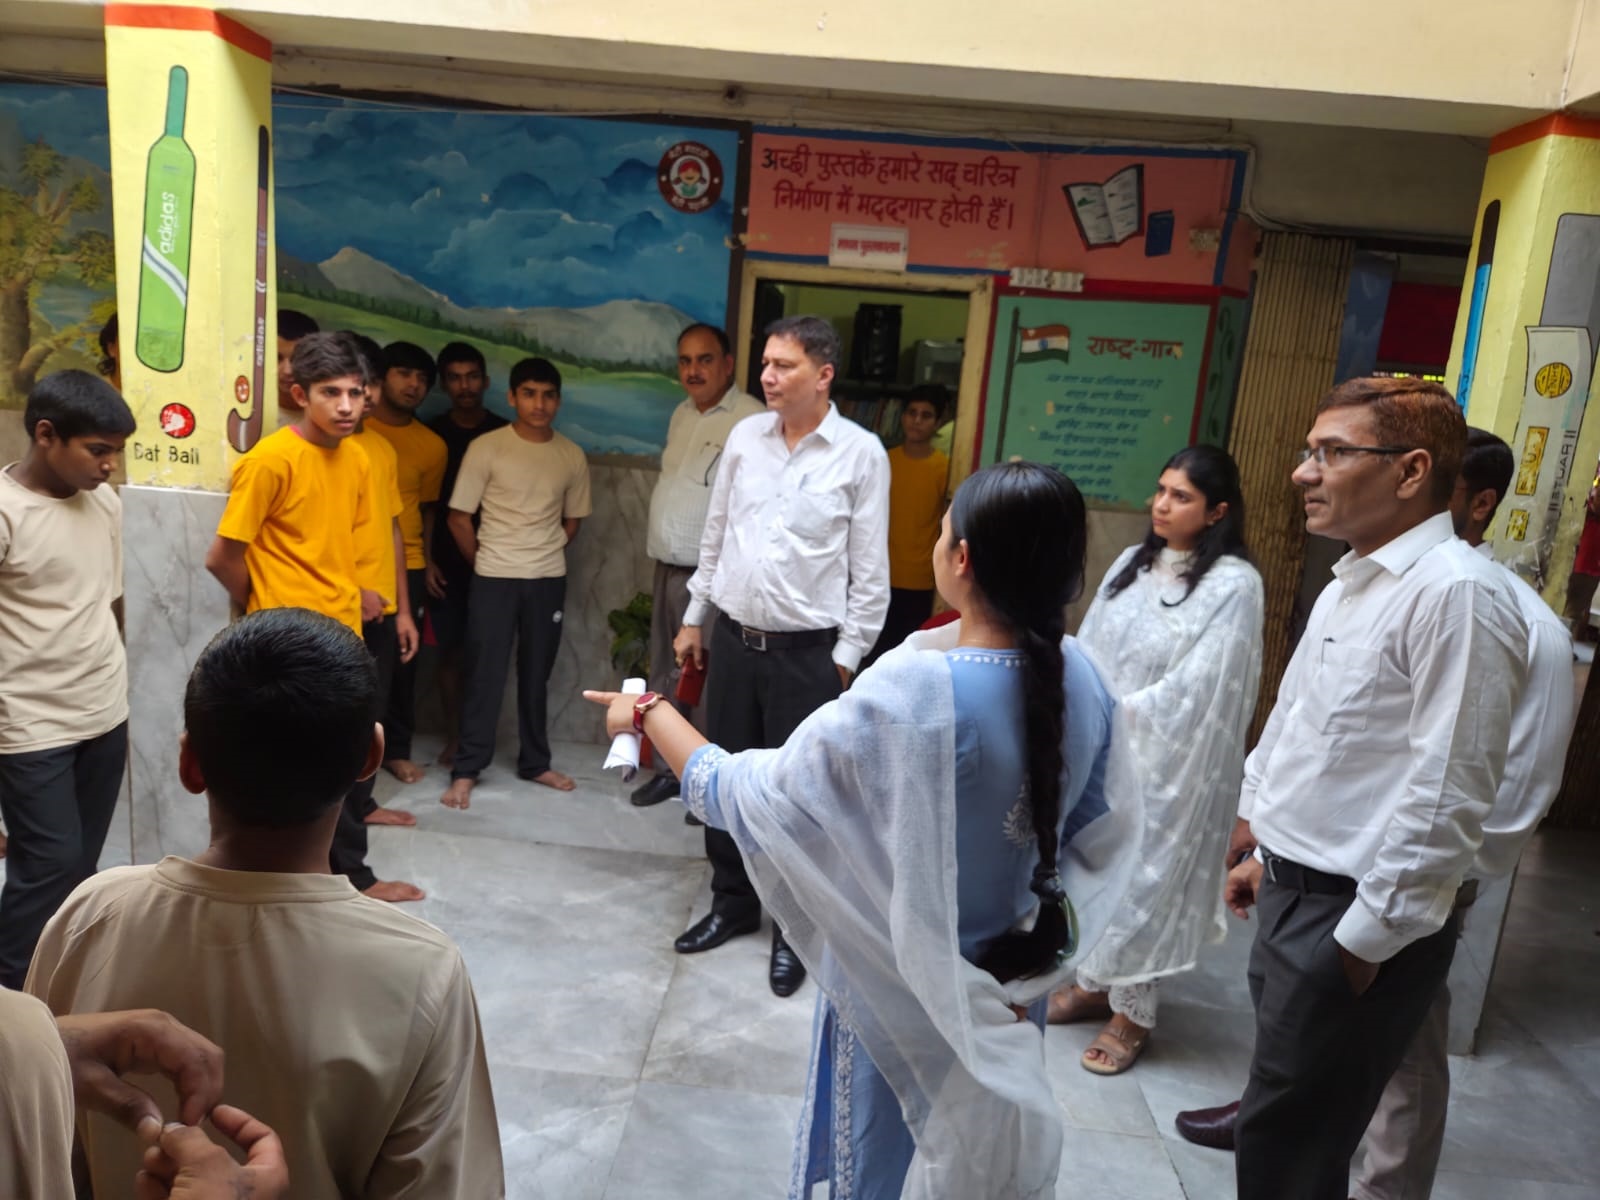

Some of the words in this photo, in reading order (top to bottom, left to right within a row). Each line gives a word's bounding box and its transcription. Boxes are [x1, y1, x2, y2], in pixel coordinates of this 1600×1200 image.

[815, 149, 876, 181] पुस्तकें
[877, 151, 923, 184] हमारे
[963, 155, 1021, 187] चरित्र
[157, 191, 175, 254] adidas
[773, 179, 833, 213] निर्माण
[836, 183, 855, 214] में
[939, 194, 984, 228] होती
